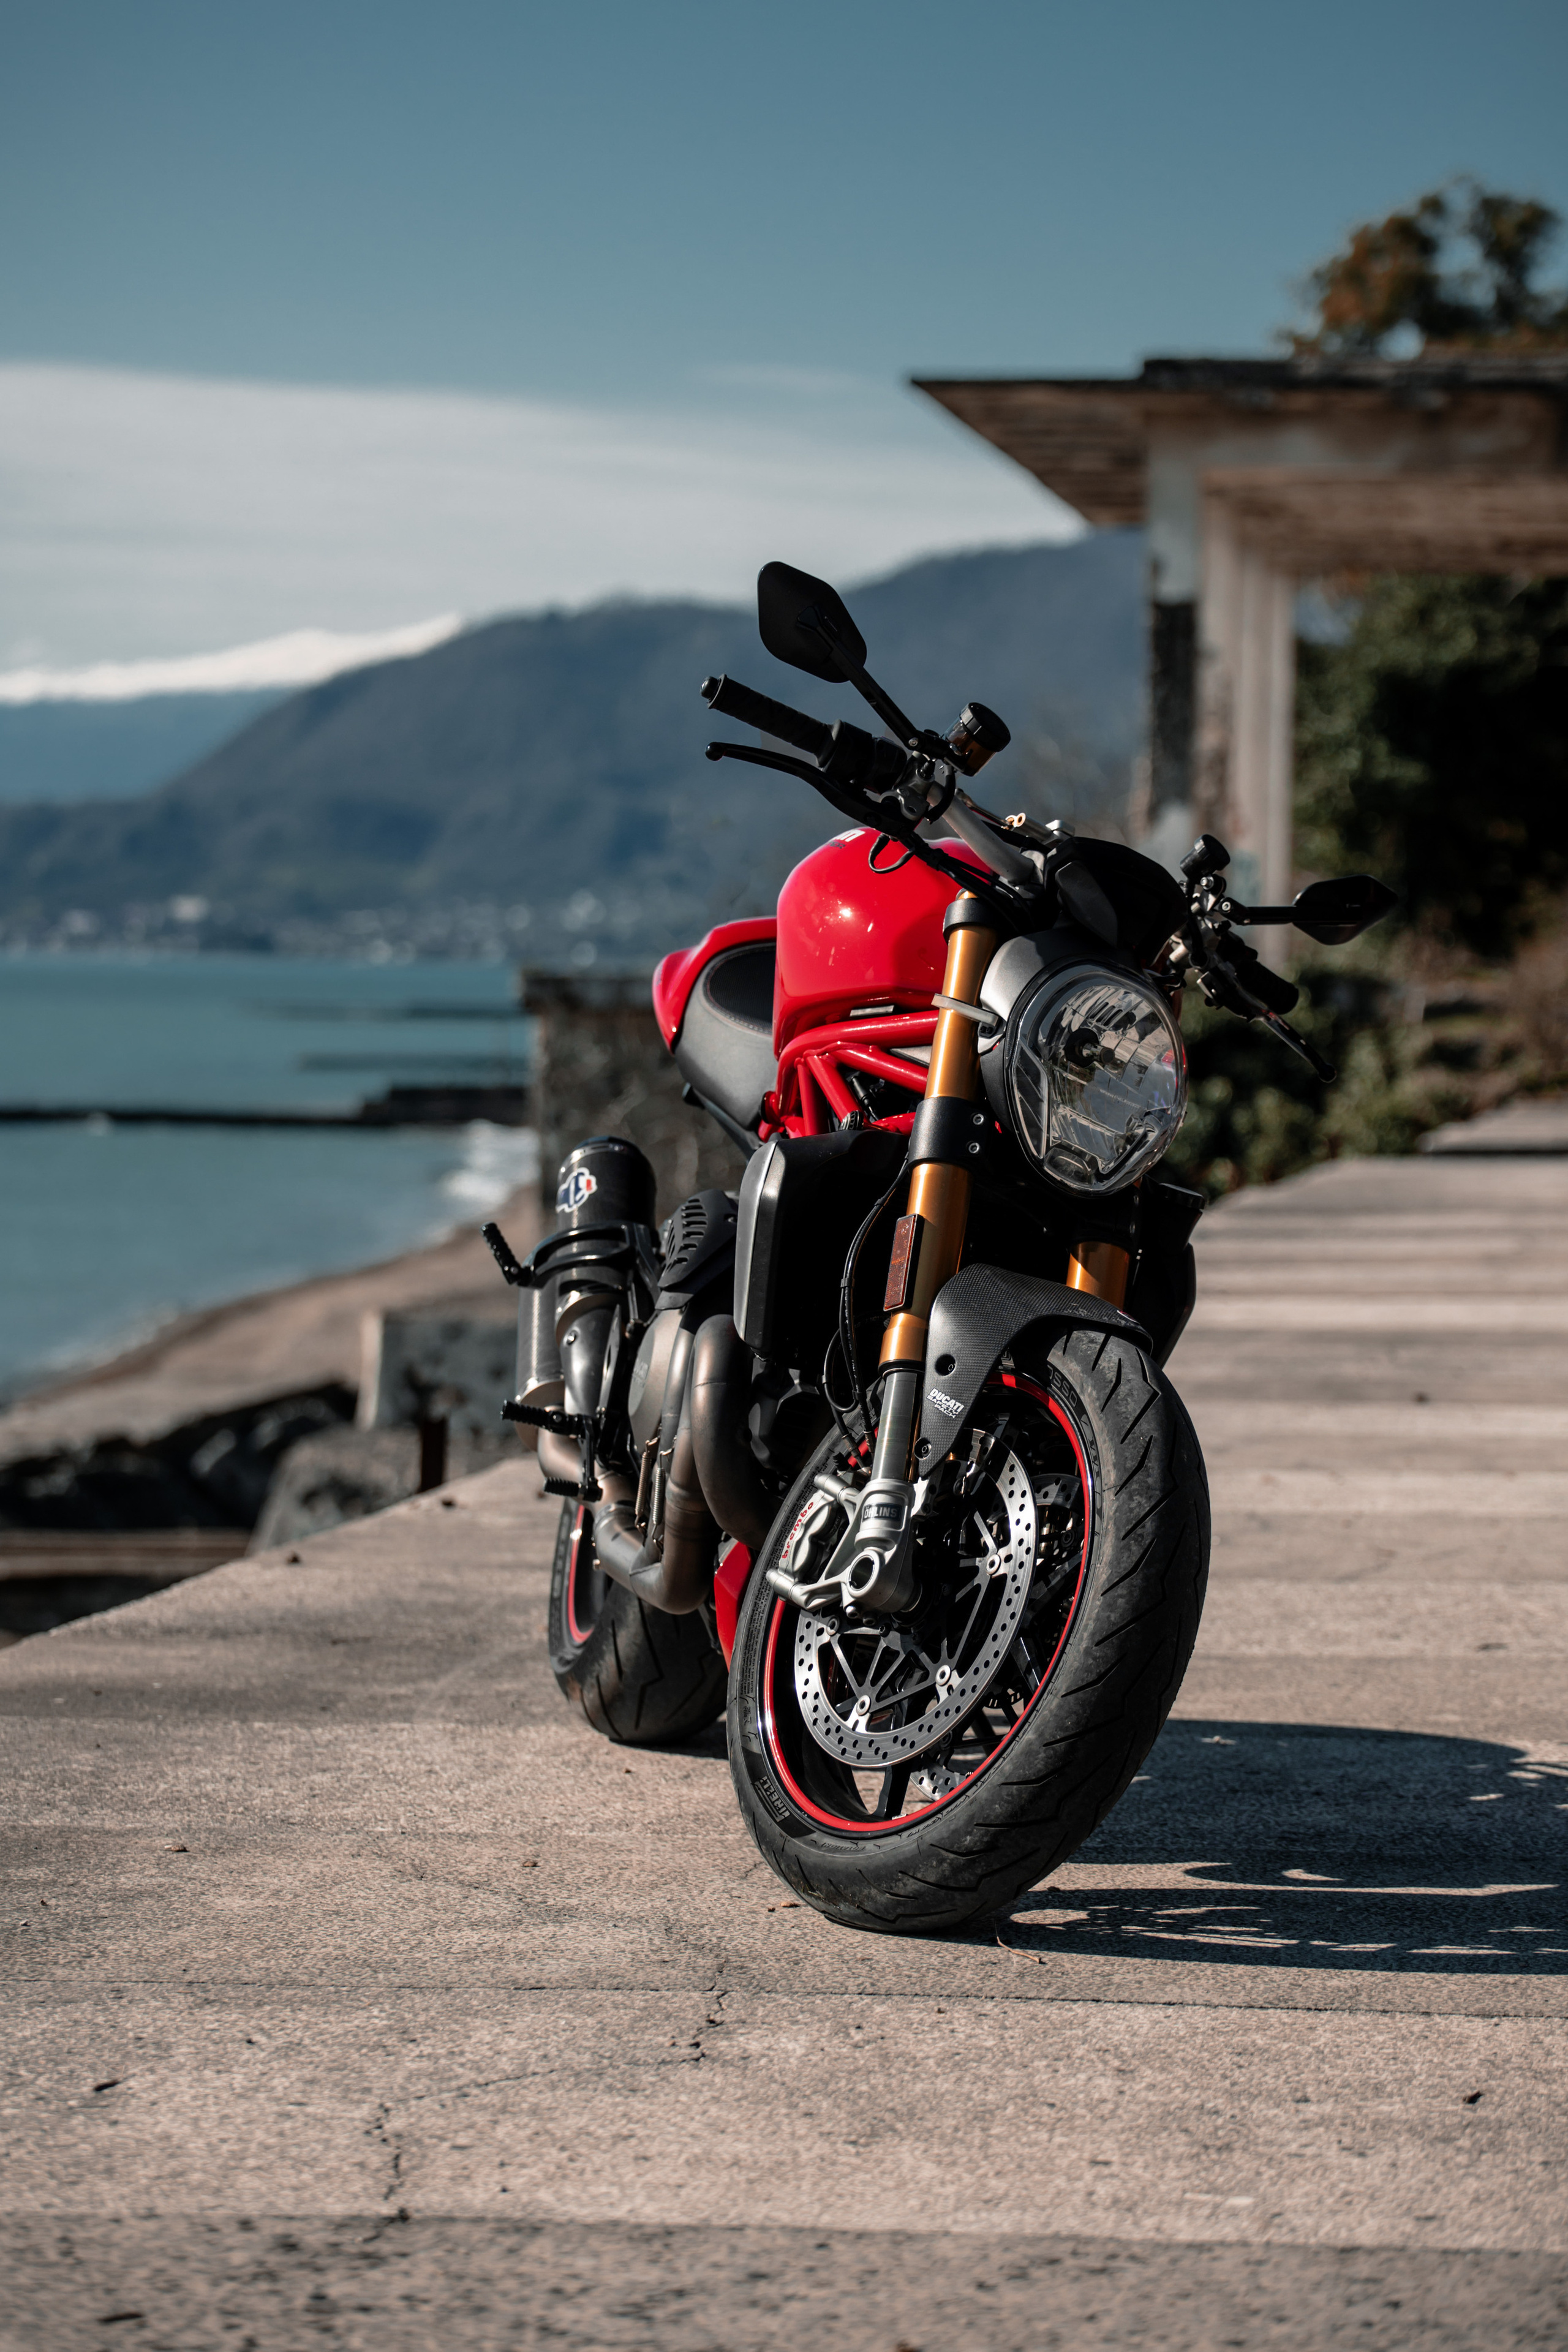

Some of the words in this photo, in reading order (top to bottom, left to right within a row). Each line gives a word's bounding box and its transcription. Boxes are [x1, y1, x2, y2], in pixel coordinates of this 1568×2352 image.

[927, 1395, 959, 1414] SAFETY
[929, 1388, 965, 1412] DUCATI
[934, 1404, 956, 1419] PACK
[864, 1506, 898, 1518] ÖHLINS
[782, 1502, 814, 1559] brembo
[752, 1776, 790, 1822] PIRELLI
